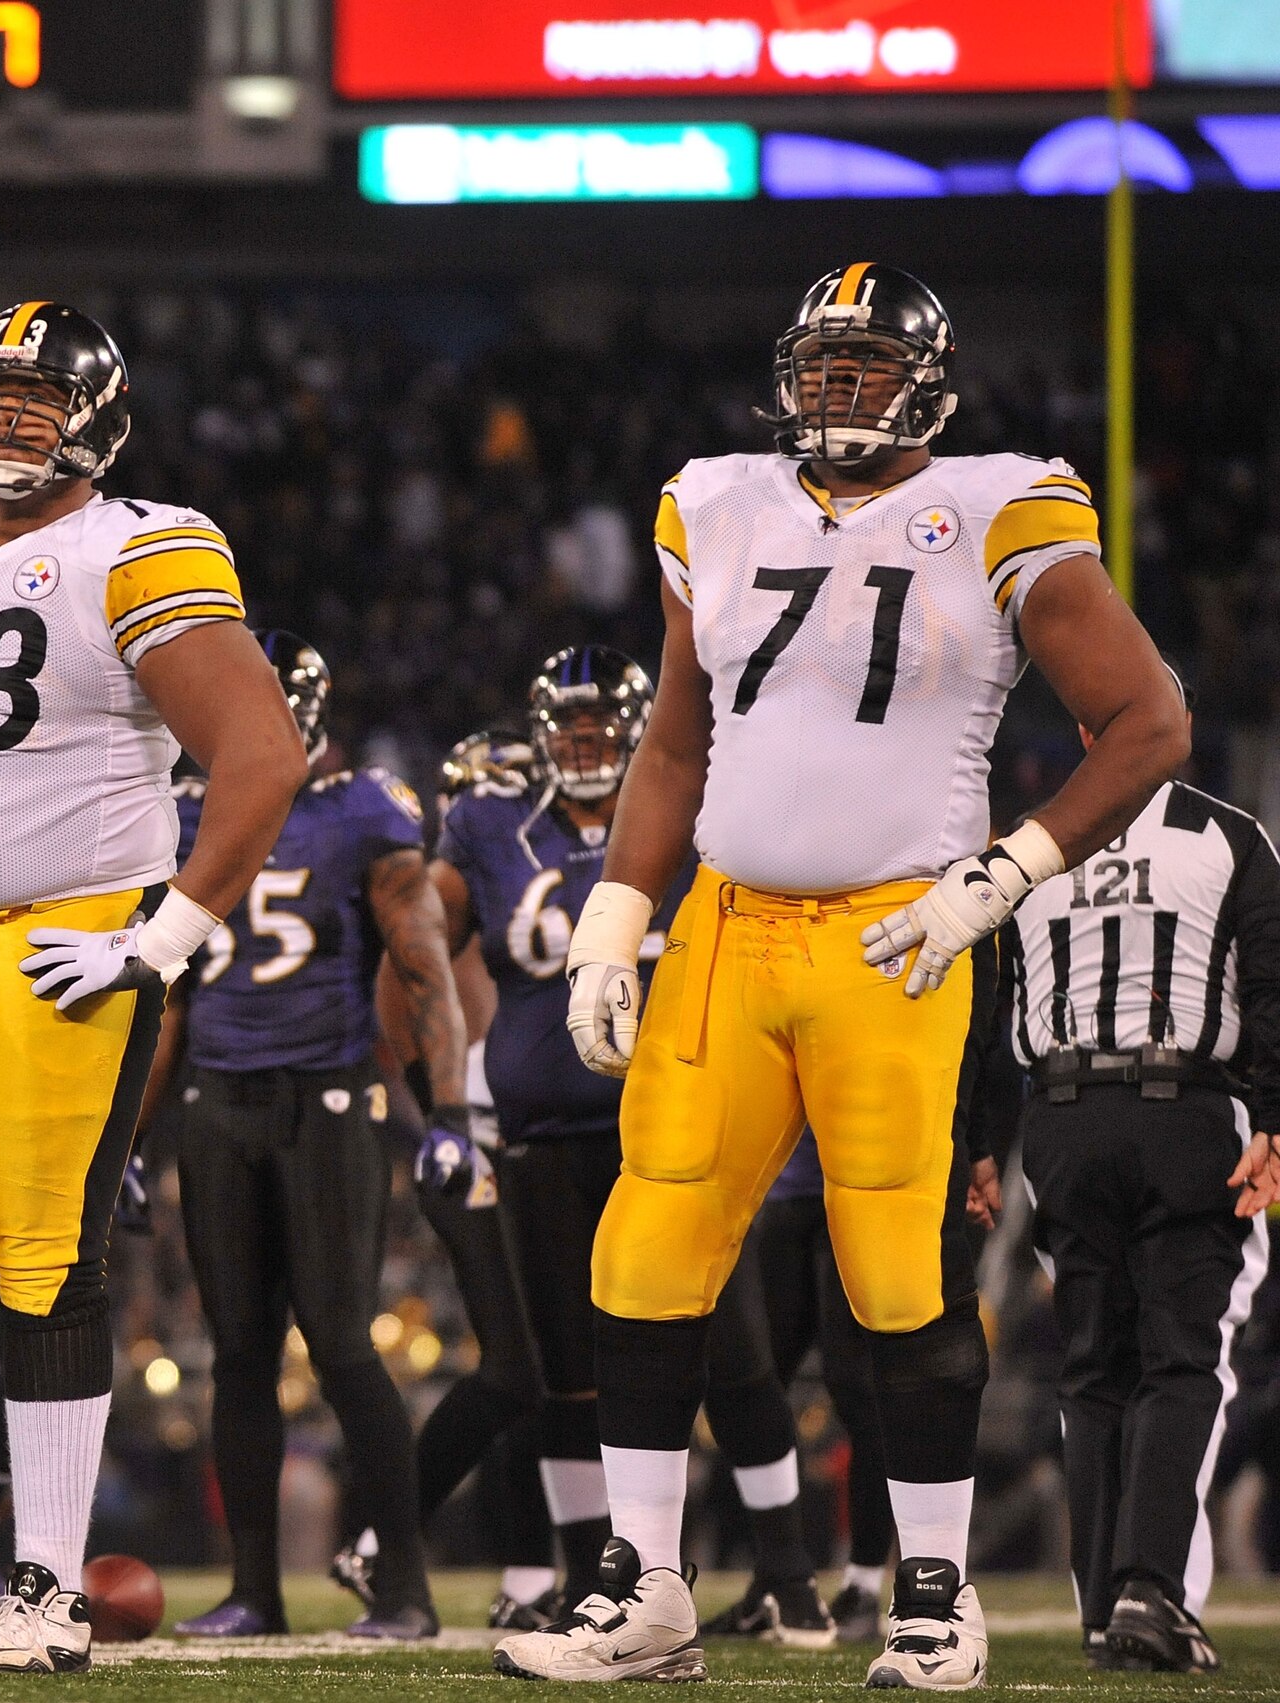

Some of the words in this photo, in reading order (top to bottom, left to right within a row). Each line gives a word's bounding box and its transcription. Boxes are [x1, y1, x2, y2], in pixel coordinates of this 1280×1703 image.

[819, 278, 876, 308] 71
[732, 565, 915, 725] 71
[1070, 858, 1154, 909] 121
